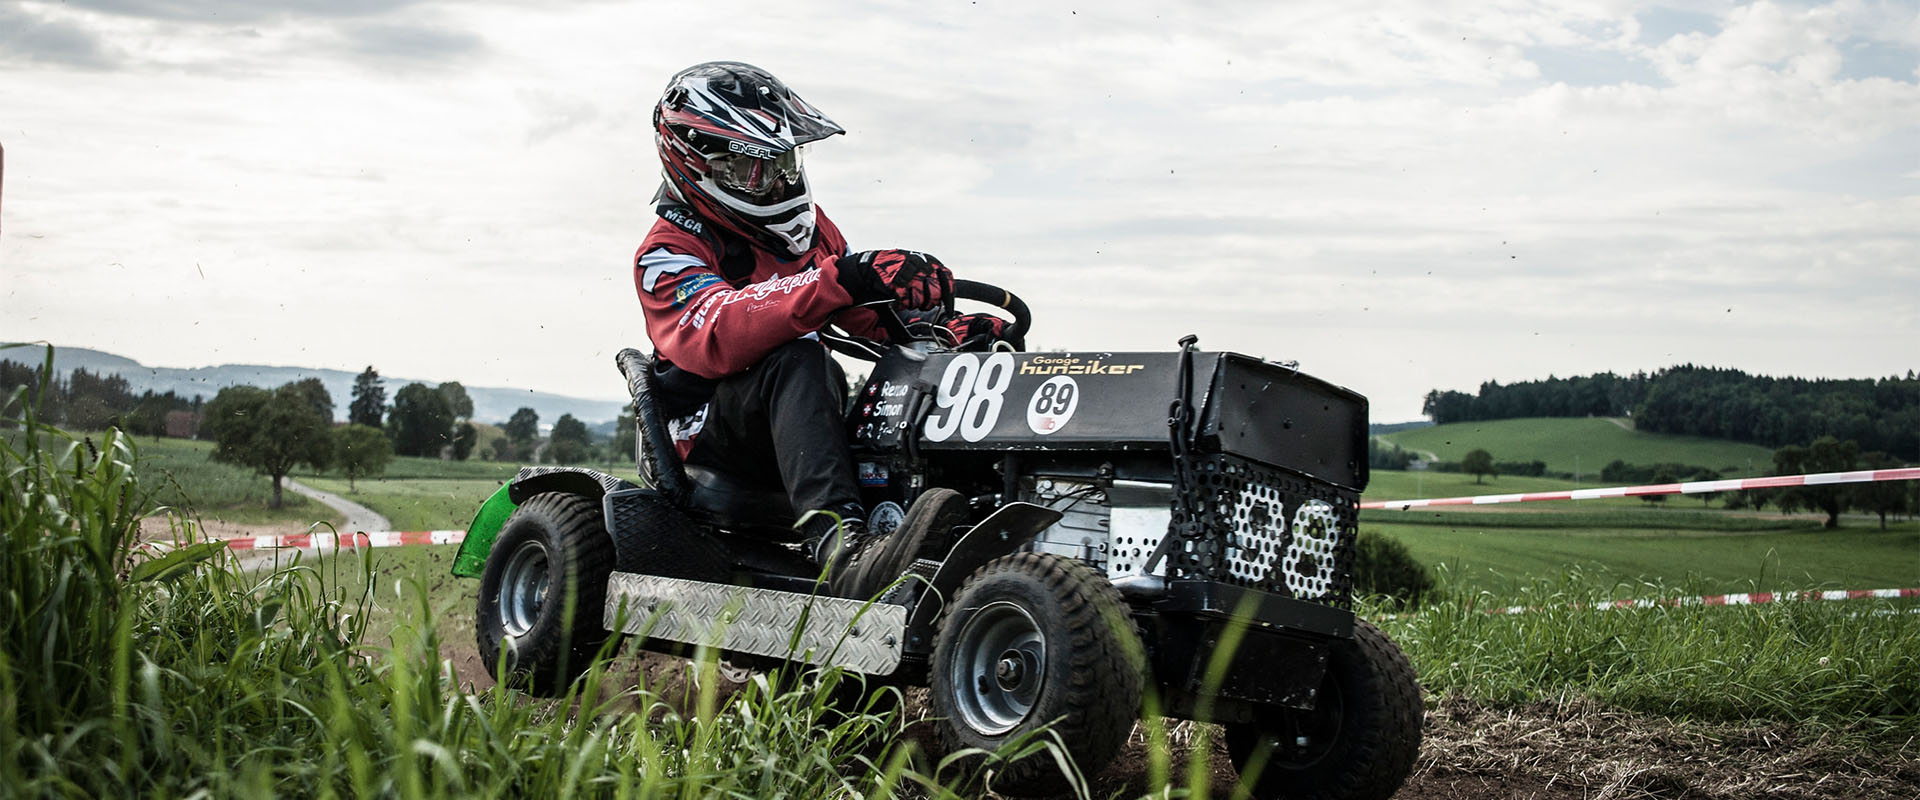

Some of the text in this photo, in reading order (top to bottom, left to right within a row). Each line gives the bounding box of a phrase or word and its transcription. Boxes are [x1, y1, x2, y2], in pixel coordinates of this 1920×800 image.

[665, 209, 703, 233] MEGA
[1019, 360, 1145, 375] hunziker
[1033, 356, 1080, 366] Garage
[924, 352, 1015, 443] 98
[1035, 382, 1075, 415] 89
[873, 400, 904, 417] Simon
